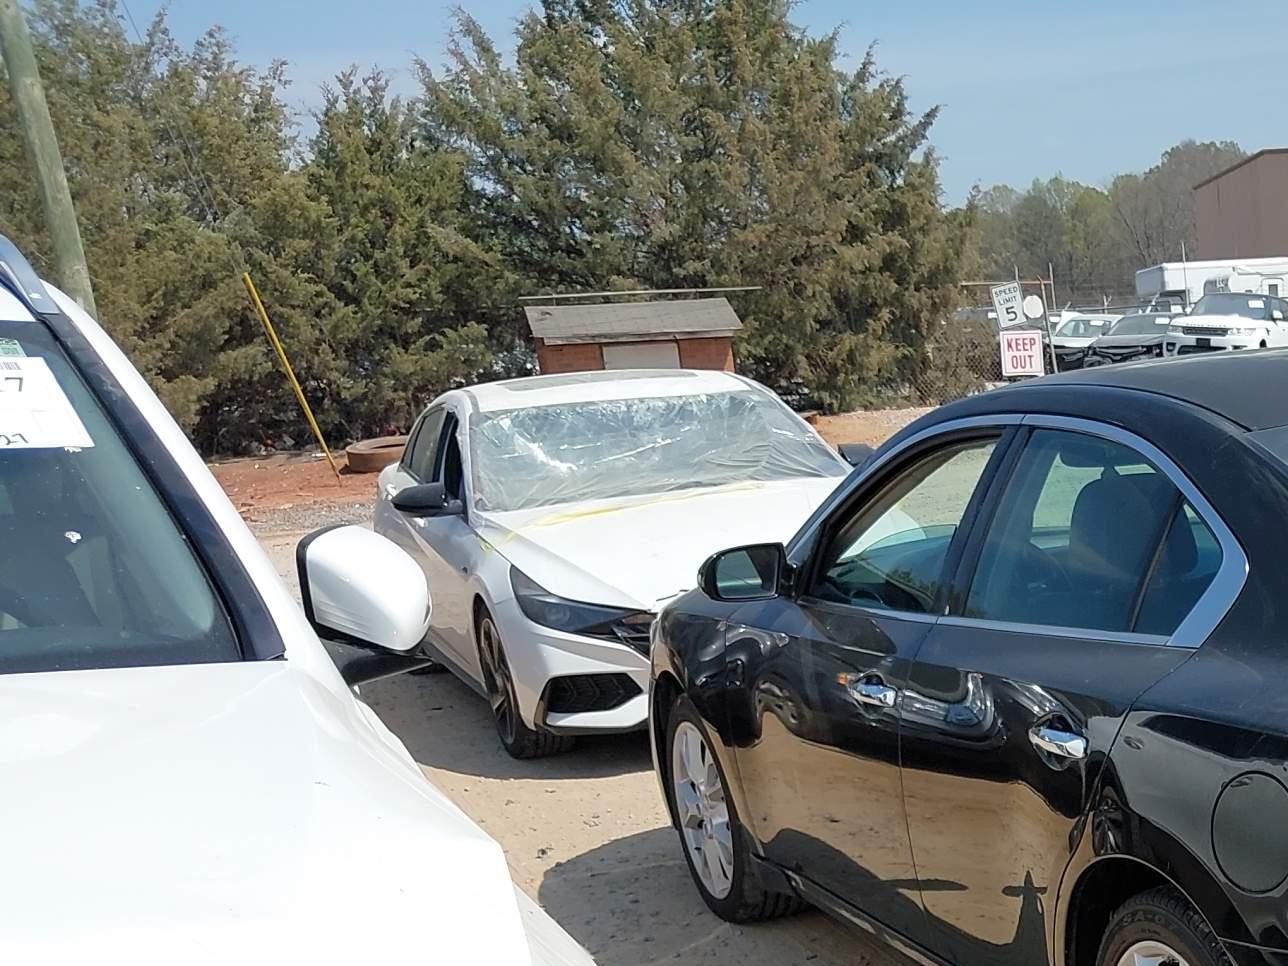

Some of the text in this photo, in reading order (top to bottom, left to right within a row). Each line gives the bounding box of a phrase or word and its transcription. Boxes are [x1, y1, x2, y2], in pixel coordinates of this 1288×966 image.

[994, 286, 1018, 298] SPEED
[998, 295, 1017, 306] LIMIT
[1005, 306, 1018, 322] 5
[1007, 338, 1036, 352] KEEP
[1011, 355, 1034, 370] OUT
